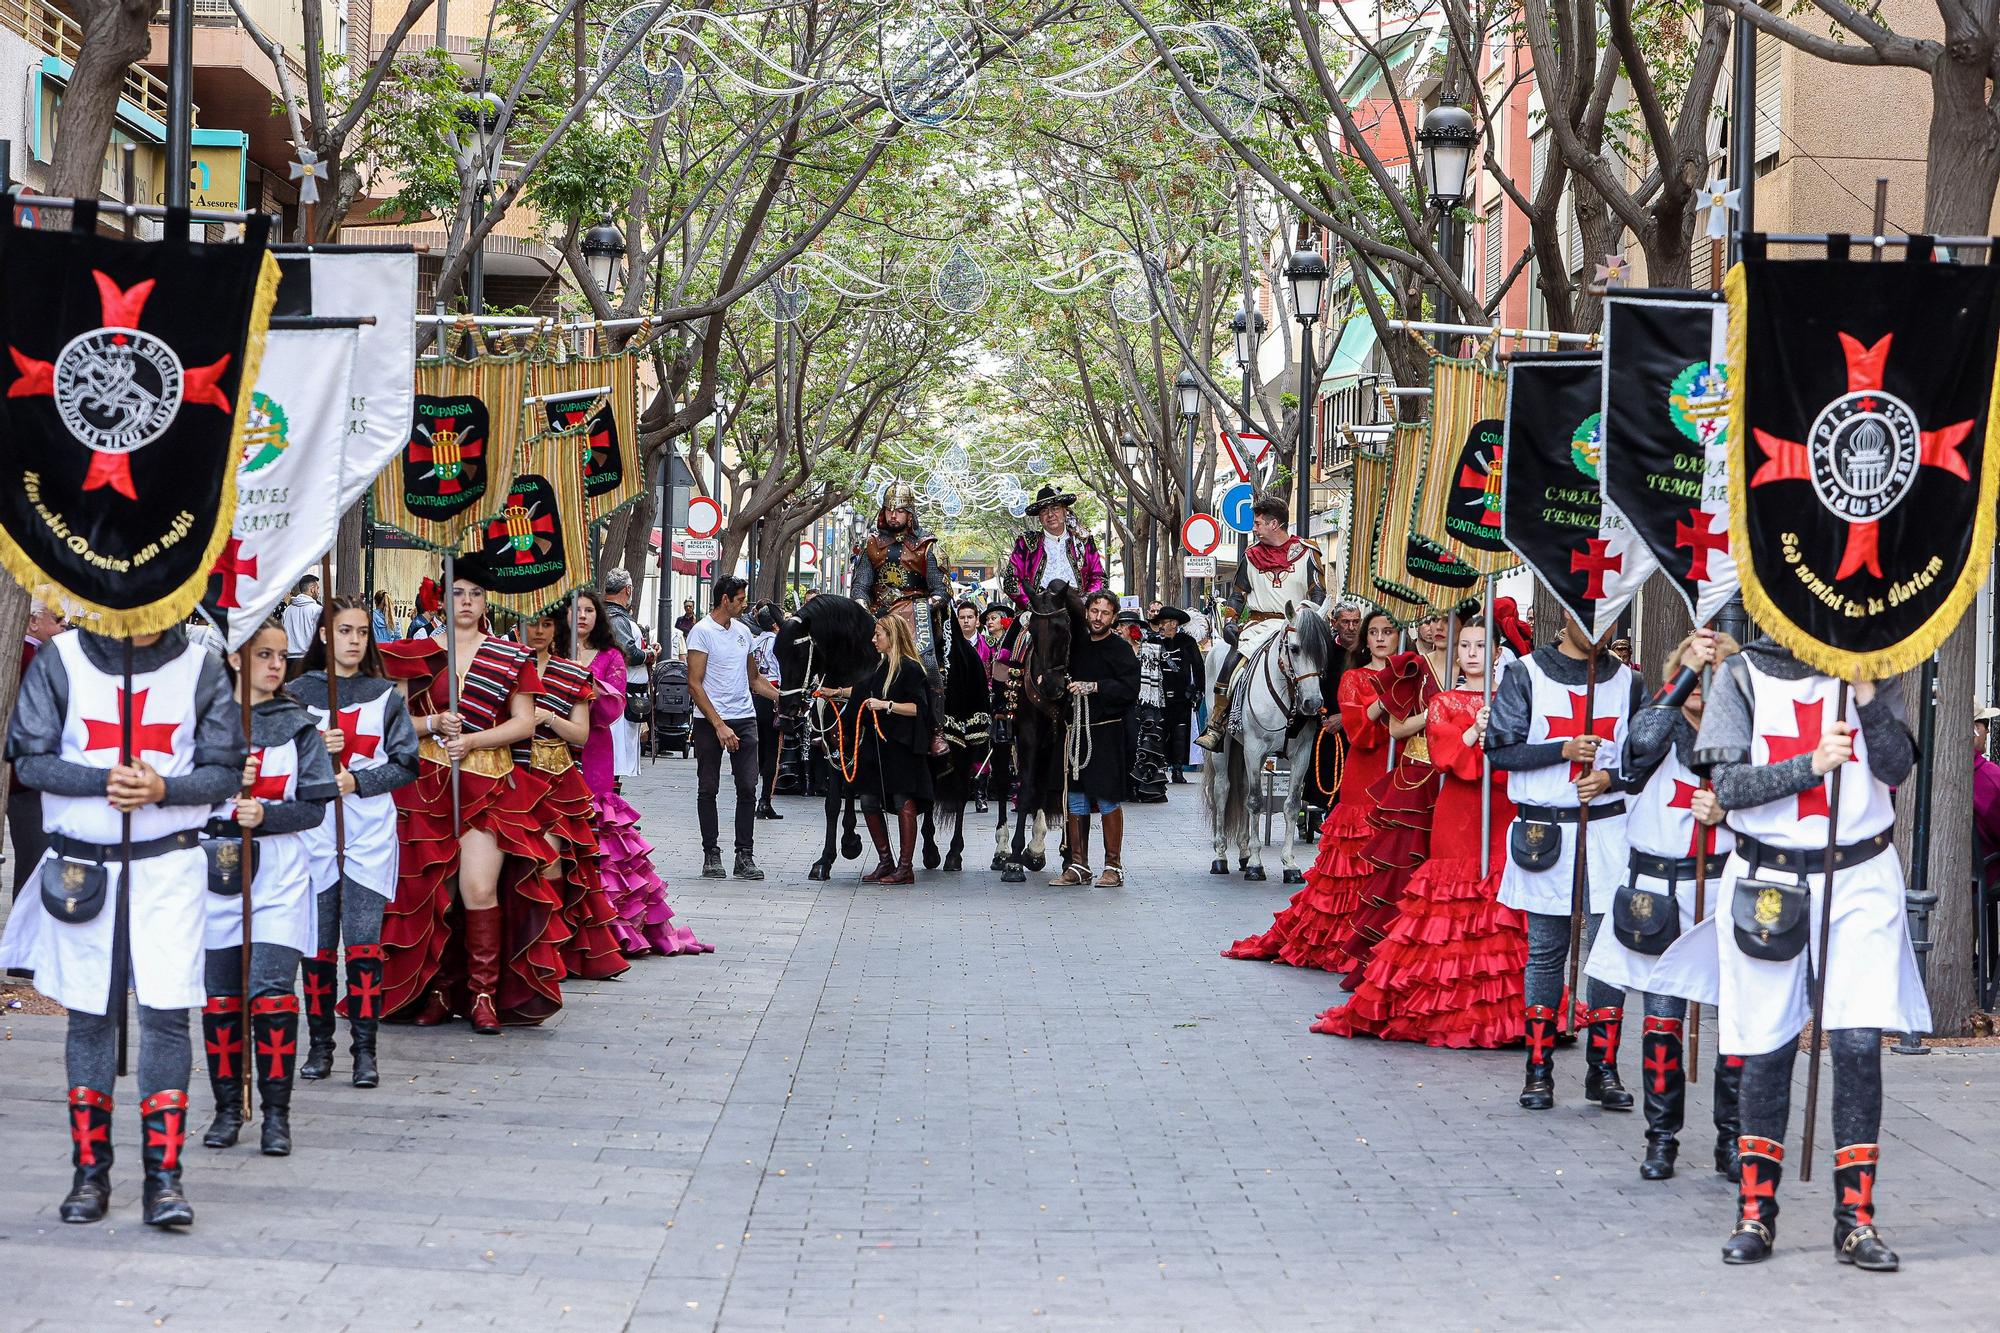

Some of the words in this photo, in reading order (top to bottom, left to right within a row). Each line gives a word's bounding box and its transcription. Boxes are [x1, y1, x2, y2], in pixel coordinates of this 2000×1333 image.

[195, 194, 238, 208] Asesores
[555, 401, 592, 413] COMPARS
[1544, 486, 1608, 506] CABAL
[159, 510, 195, 549] nobis
[239, 512, 290, 532] SANTA
[1781, 532, 1803, 564] Sed
[1795, 564, 1845, 611] nomini
[1888, 555, 1944, 607] gloriam
